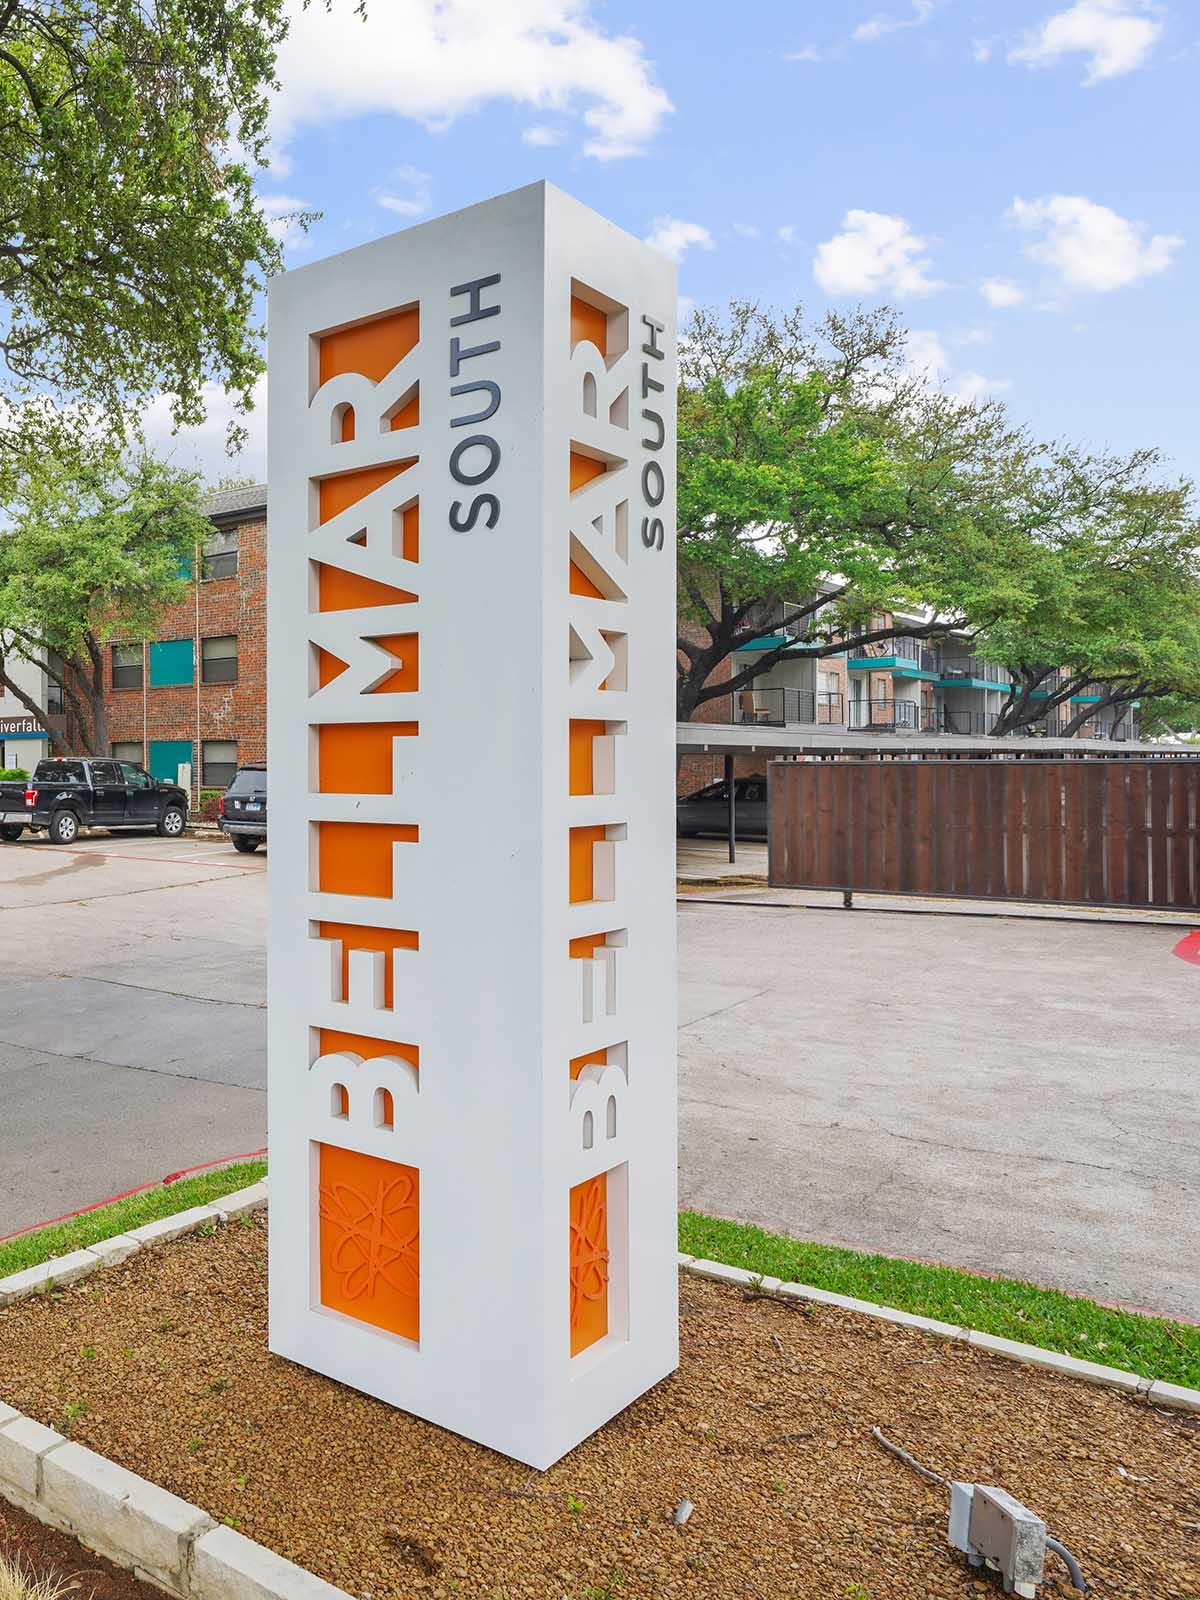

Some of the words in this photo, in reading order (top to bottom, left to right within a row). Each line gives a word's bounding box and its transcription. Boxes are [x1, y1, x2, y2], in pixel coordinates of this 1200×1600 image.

[449, 273, 501, 533] SOUTH
[641, 314, 665, 551] SOUTH
[308, 338, 420, 1168] BELLMAR
[569, 346, 629, 1188] BELLMAR
